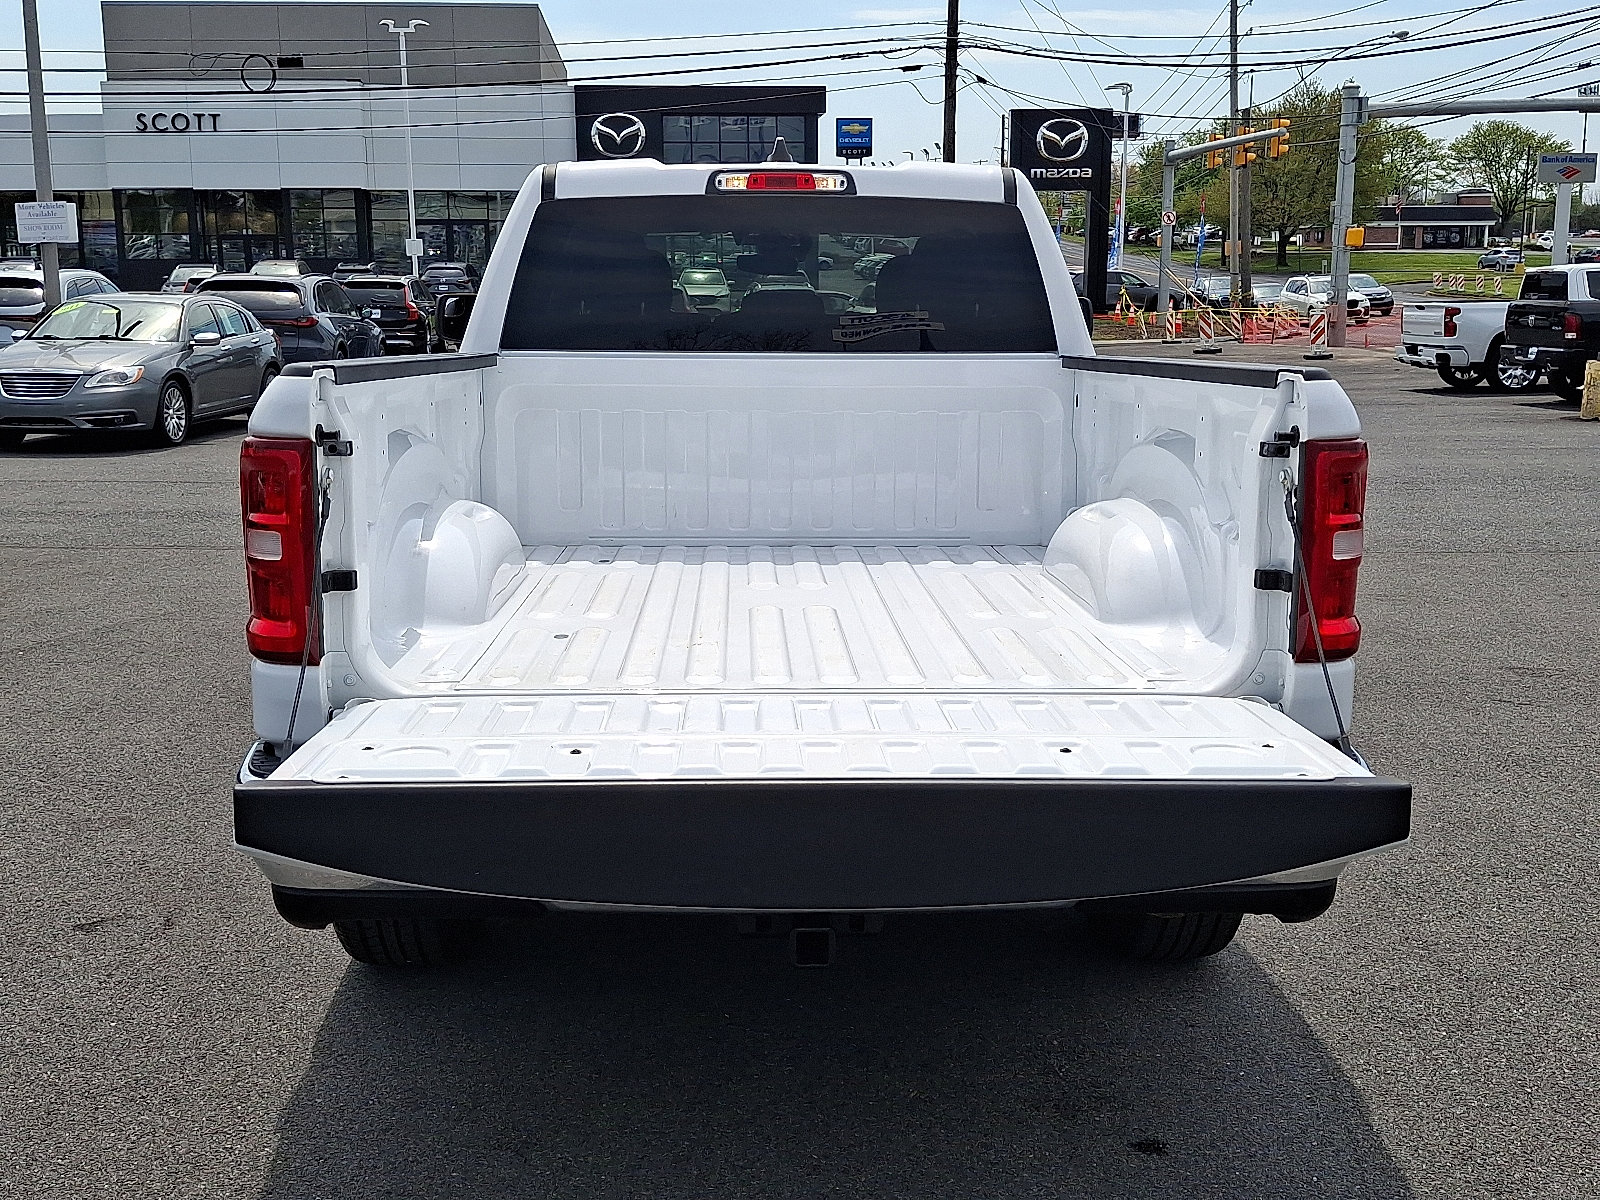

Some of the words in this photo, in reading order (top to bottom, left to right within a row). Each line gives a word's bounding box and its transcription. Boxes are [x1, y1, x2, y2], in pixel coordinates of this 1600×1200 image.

[136, 112, 221, 132] SCOTT
[1030, 168, 1093, 179] mazda
[38, 202, 64, 210] Vehicles
